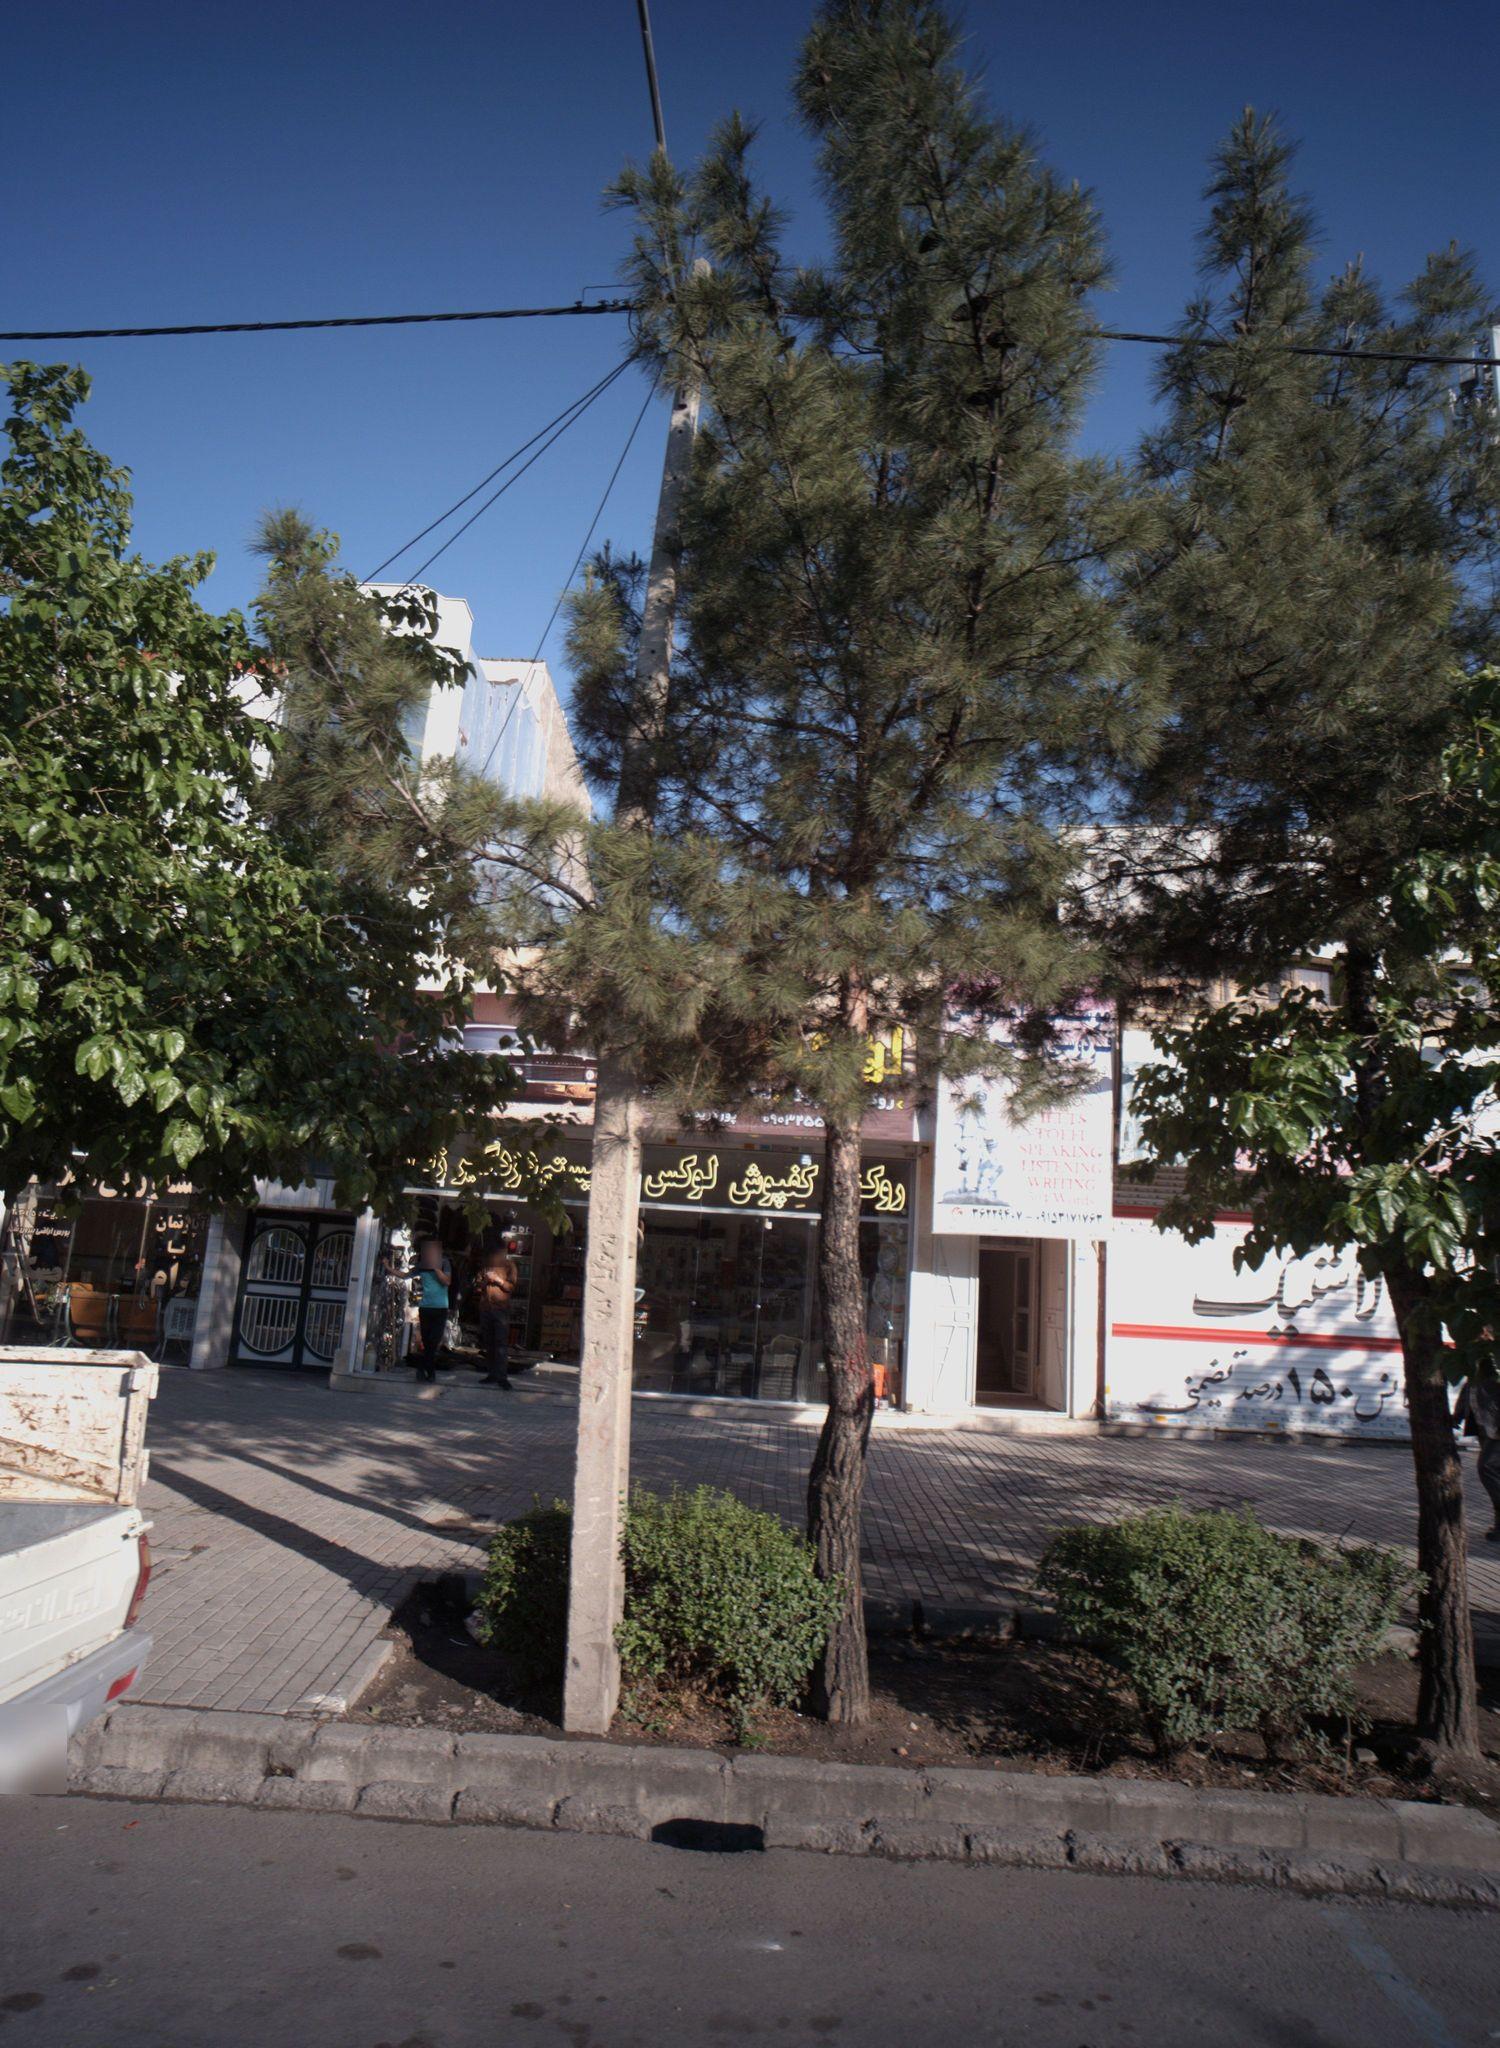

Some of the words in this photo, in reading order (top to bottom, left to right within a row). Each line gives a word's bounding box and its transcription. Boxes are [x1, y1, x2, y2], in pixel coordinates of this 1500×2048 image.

[645, 1155, 719, 1199] لوکس
[729, 1164, 818, 1209] کفپوش
[860, 1165, 906, 1211] روک
[156, 1213, 206, 1239] آپارتمان
[166, 1240, 187, 1260] با
[1136, 1350, 1248, 1415] تضمینی
[1236, 1381, 1284, 1402] درصد
[1287, 1366, 1353, 1405] ۱۵۰
